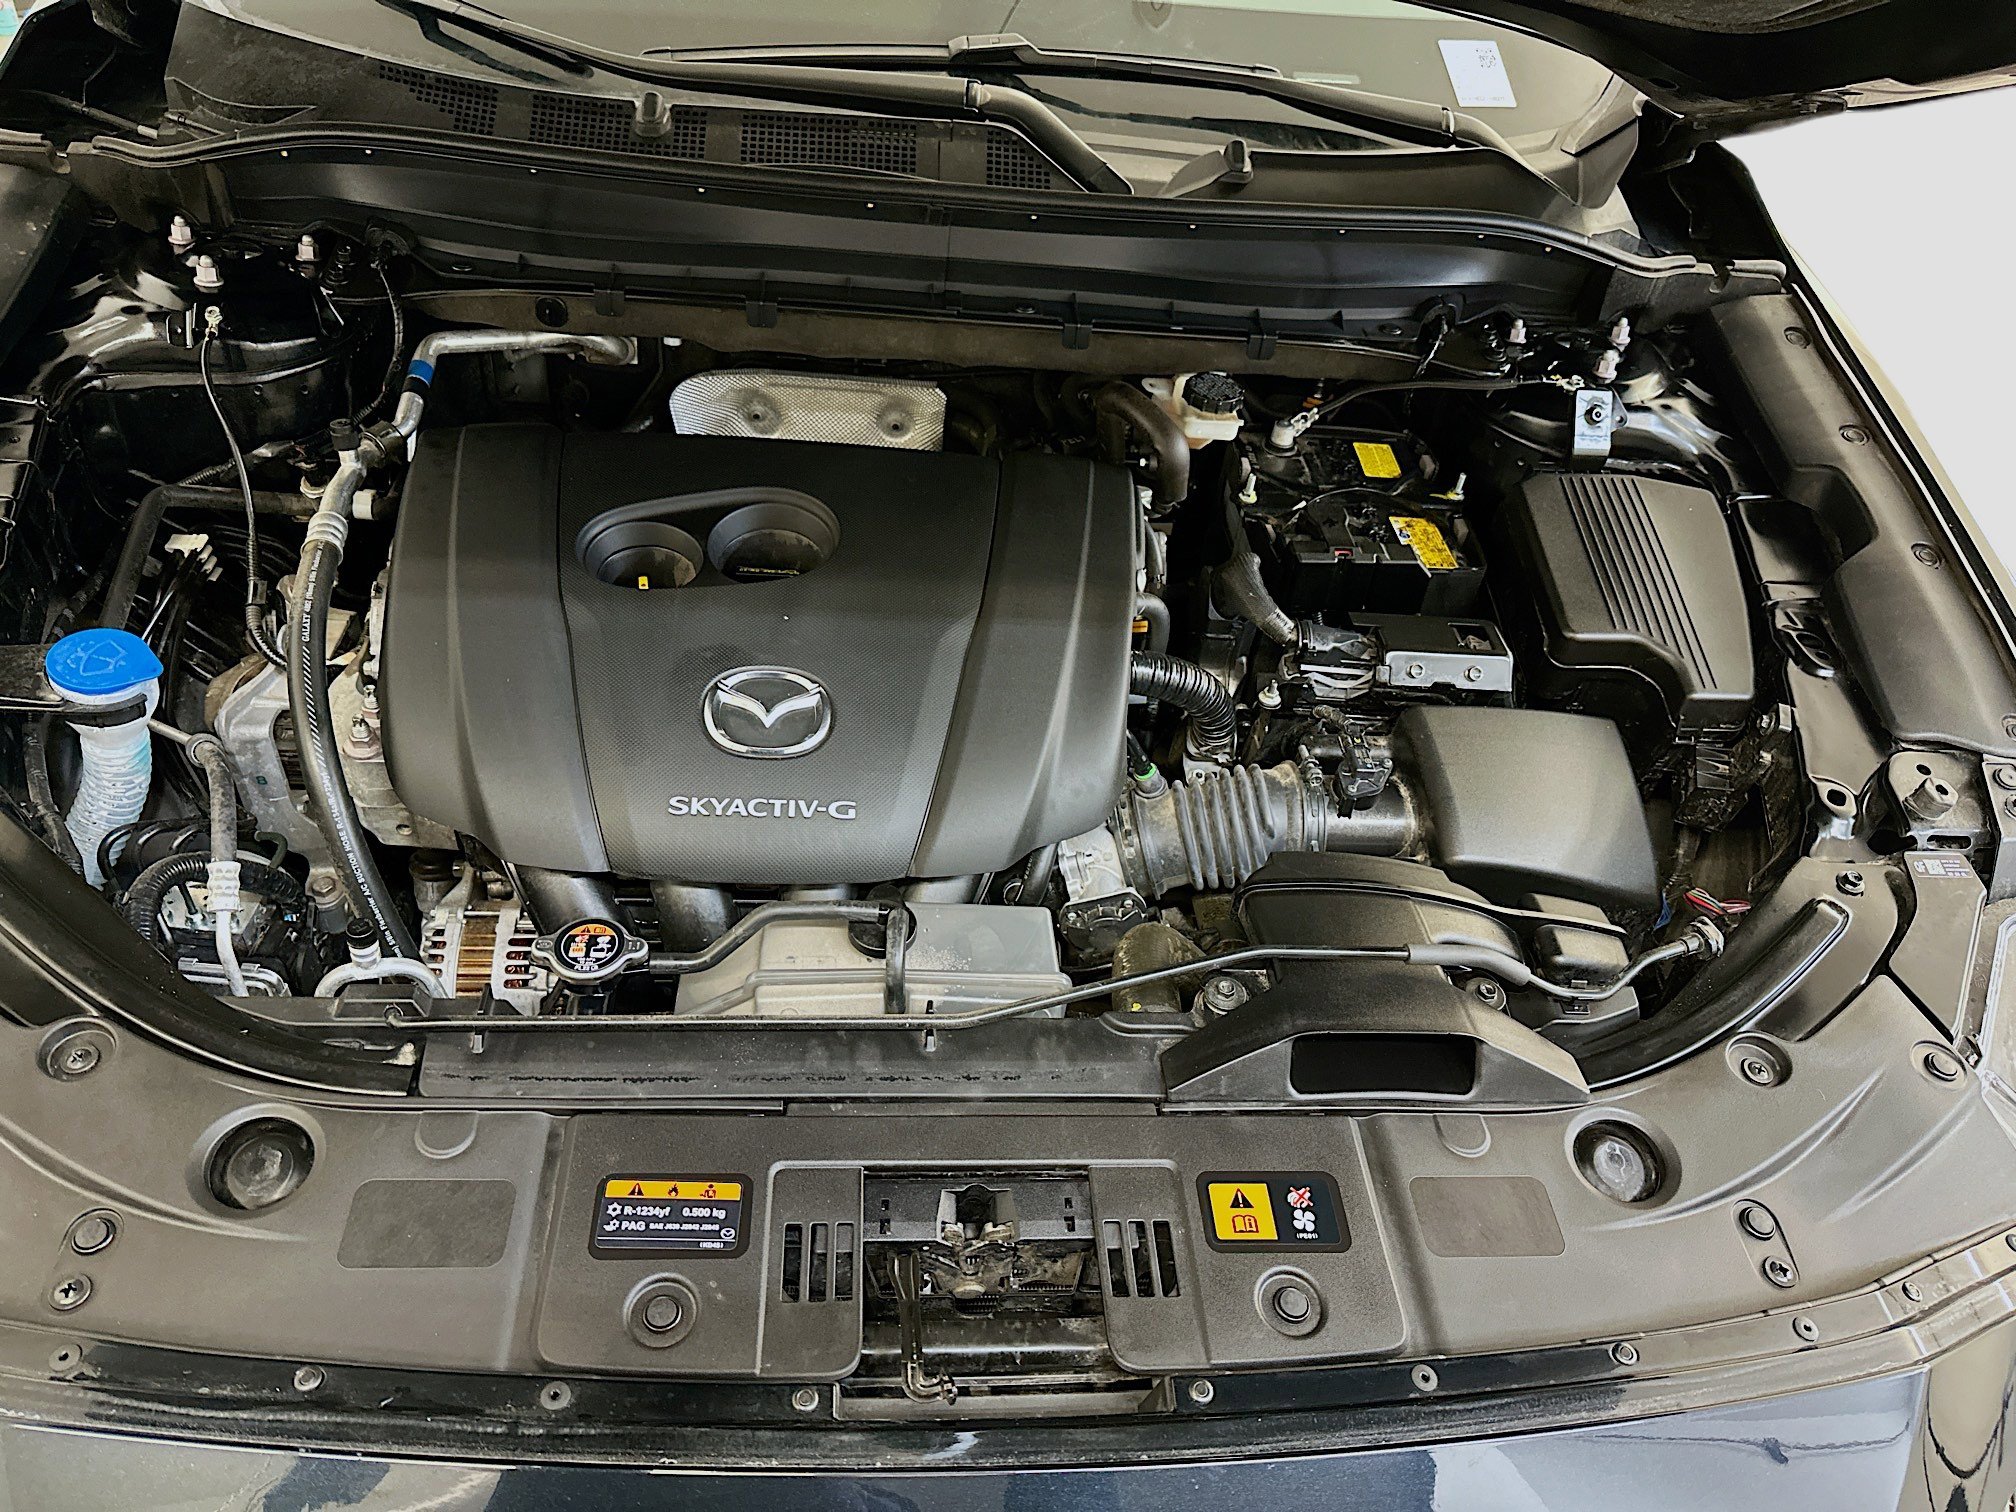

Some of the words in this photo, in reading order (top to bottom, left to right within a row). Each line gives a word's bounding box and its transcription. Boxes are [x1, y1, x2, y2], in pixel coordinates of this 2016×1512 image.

[301, 612, 311, 642] GALAXY
[667, 796, 857, 820] SKYACTIV-G
[339, 830, 352, 852] HOSE
[347, 852, 365, 884] SUCTION
[360, 883, 371, 896] A/C
[367, 897, 388, 931] Flexbarrier
[623, 1205, 671, 1219] R-1234yf
[682, 1206, 711, 1218] 0.500
[712, 1207, 727, 1220] kg
[621, 1220, 646, 1232] PAG
